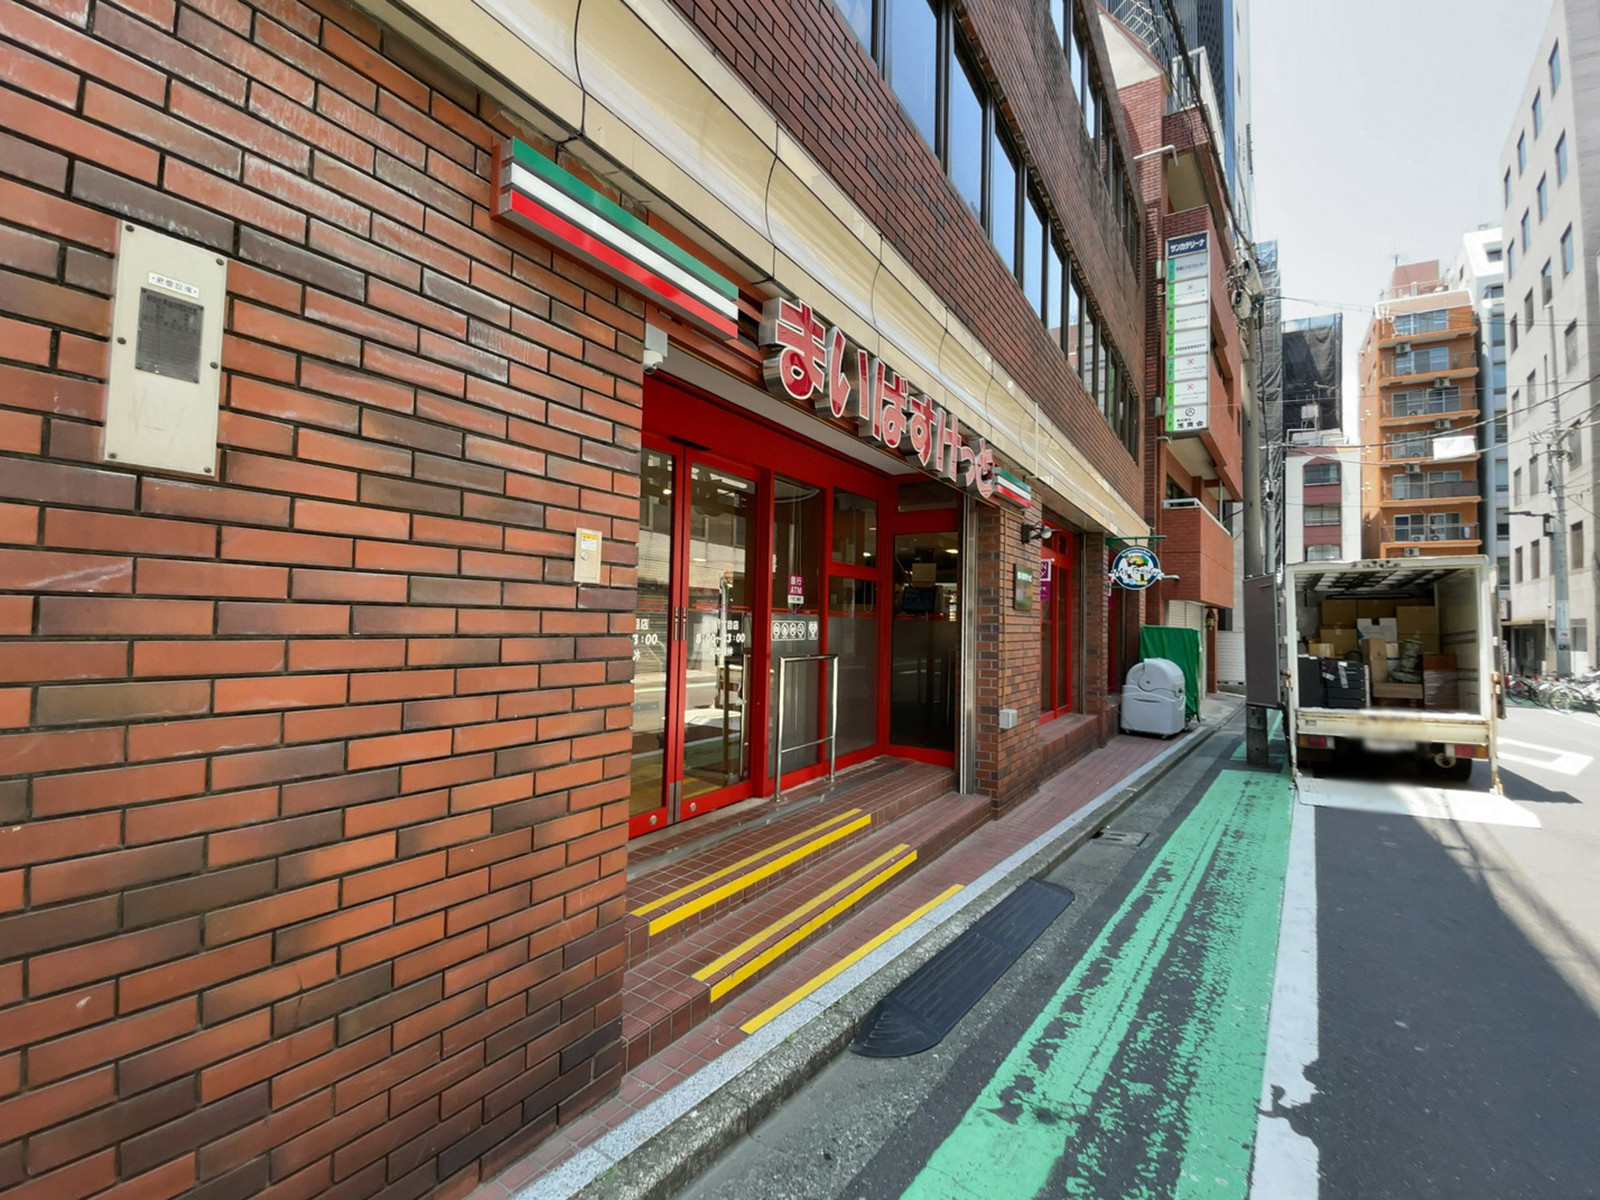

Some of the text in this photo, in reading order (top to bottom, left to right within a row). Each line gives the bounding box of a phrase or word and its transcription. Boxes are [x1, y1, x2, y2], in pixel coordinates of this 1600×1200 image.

[771, 296, 994, 498] まいばすけっと
[790, 586, 802, 594] ATM
